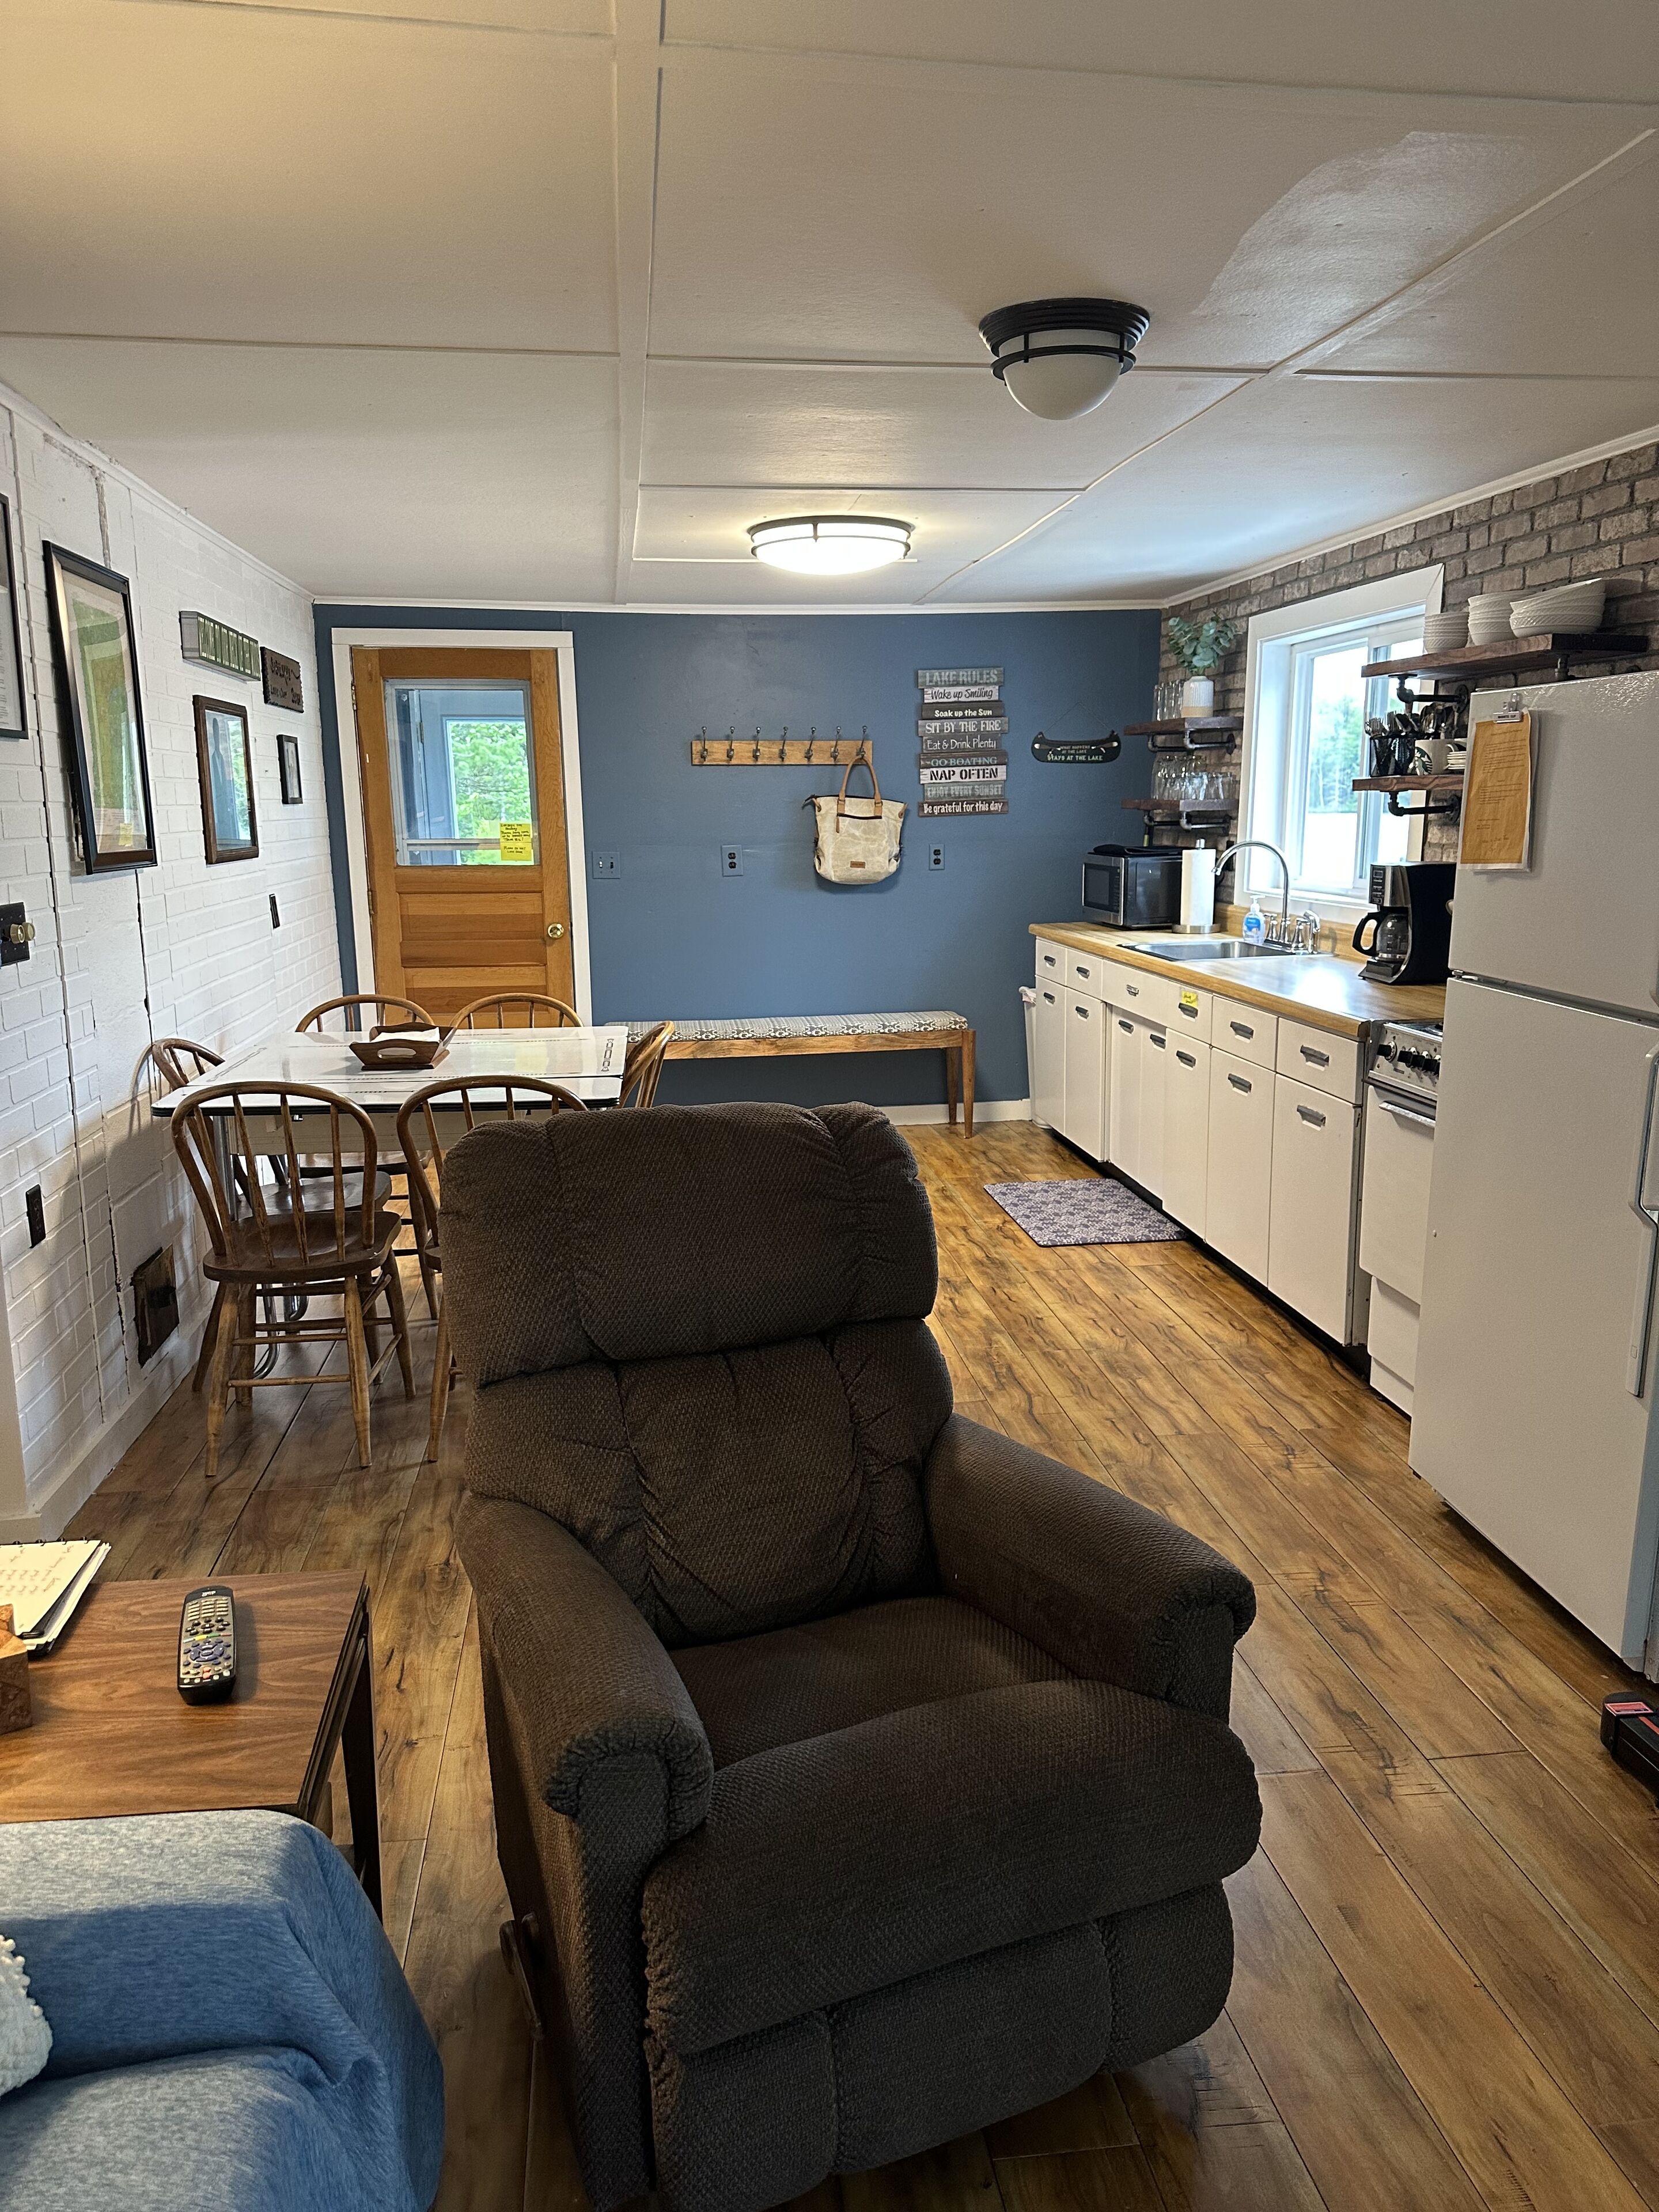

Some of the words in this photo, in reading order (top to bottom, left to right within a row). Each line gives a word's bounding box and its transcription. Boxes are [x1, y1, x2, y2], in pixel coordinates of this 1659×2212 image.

[925, 672, 957, 685] LAKE
[959, 669, 998, 684] RULES
[931, 689, 952, 700] Wake
[953, 691, 963, 700] up
[964, 687, 993, 699] Smiling
[934, 710, 953, 718] Soak
[964, 709, 977, 717] the
[925, 722, 941, 734] SIT
[944, 721, 956, 733] BY
[959, 721, 978, 732] THE
[980, 719, 1001, 732] FIRE
[927, 740, 941, 750] Eat
[942, 739, 949, 749] &
[950, 735, 971, 749] Drink
[972, 734, 997, 749] Plenty
[931, 758, 947, 766] GO
[950, 756, 998, 766] BOATING
[930, 770, 956, 781] NAP
[960, 767, 998, 780] OFTEN
[927, 787, 949, 798] ENJOY
[950, 785, 973, 797] EVERY
[974, 784, 1002, 796] SUNSET
[923, 803, 933, 814] Be
[933, 802, 961, 815] grateful
[963, 801, 974, 812] for
[975, 801, 988, 812] this
[990, 801, 1003, 812] day
